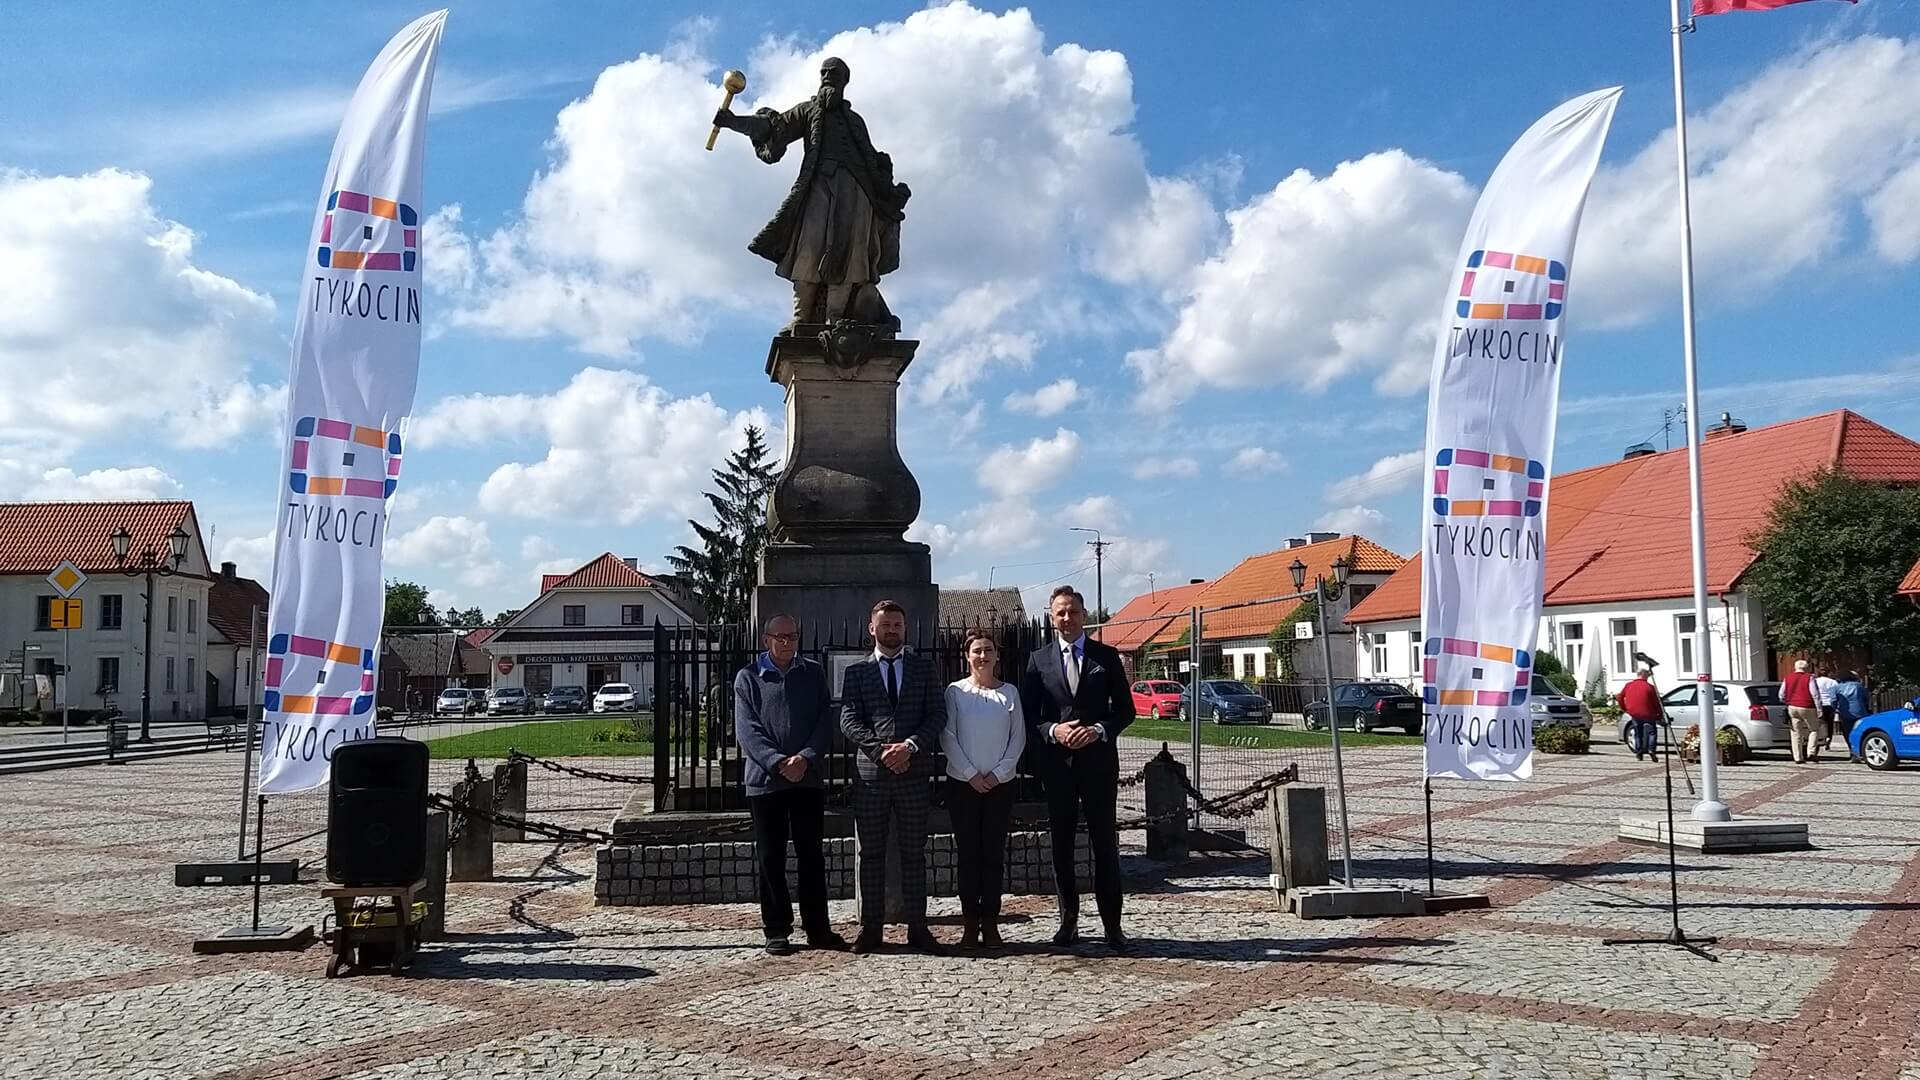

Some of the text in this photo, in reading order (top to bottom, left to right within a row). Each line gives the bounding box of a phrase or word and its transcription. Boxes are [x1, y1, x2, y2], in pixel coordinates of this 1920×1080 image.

[315, 277, 420, 324] TYKOCIN
[1453, 327, 1557, 364] TYKOCIN
[288, 503, 387, 548] TYKOCI
[1433, 524, 1539, 561] TYKOCIN
[1422, 713, 1526, 749] TYKOCIN
